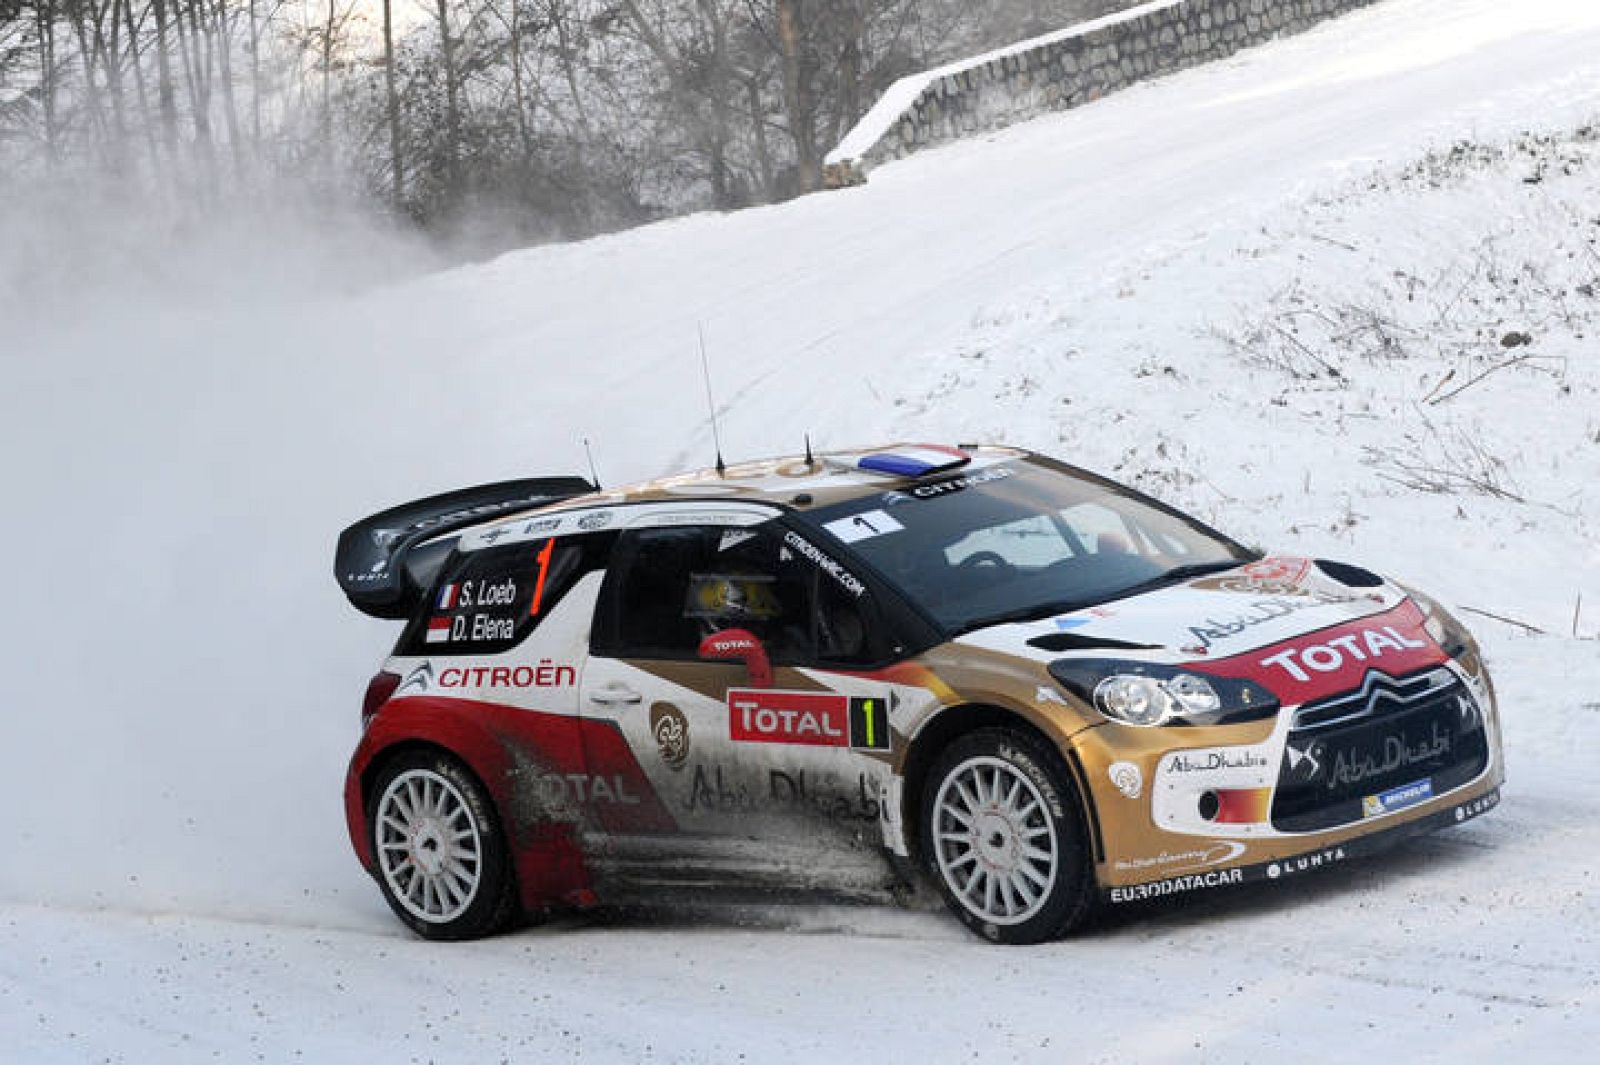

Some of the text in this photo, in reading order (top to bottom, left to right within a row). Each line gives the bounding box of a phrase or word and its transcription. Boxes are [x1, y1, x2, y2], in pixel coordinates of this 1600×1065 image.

[852, 516, 879, 534] 1
[459, 577, 517, 607] S. Loeb
[529, 537, 556, 617] 1
[452, 613, 515, 641] D. Elena
[1258, 625, 1426, 682] TOTAL
[438, 658, 577, 689] CITROËN
[862, 698, 875, 749] 1
[1283, 847, 1345, 873] LUHTA
[1109, 868, 1243, 903] EURODATACAR
